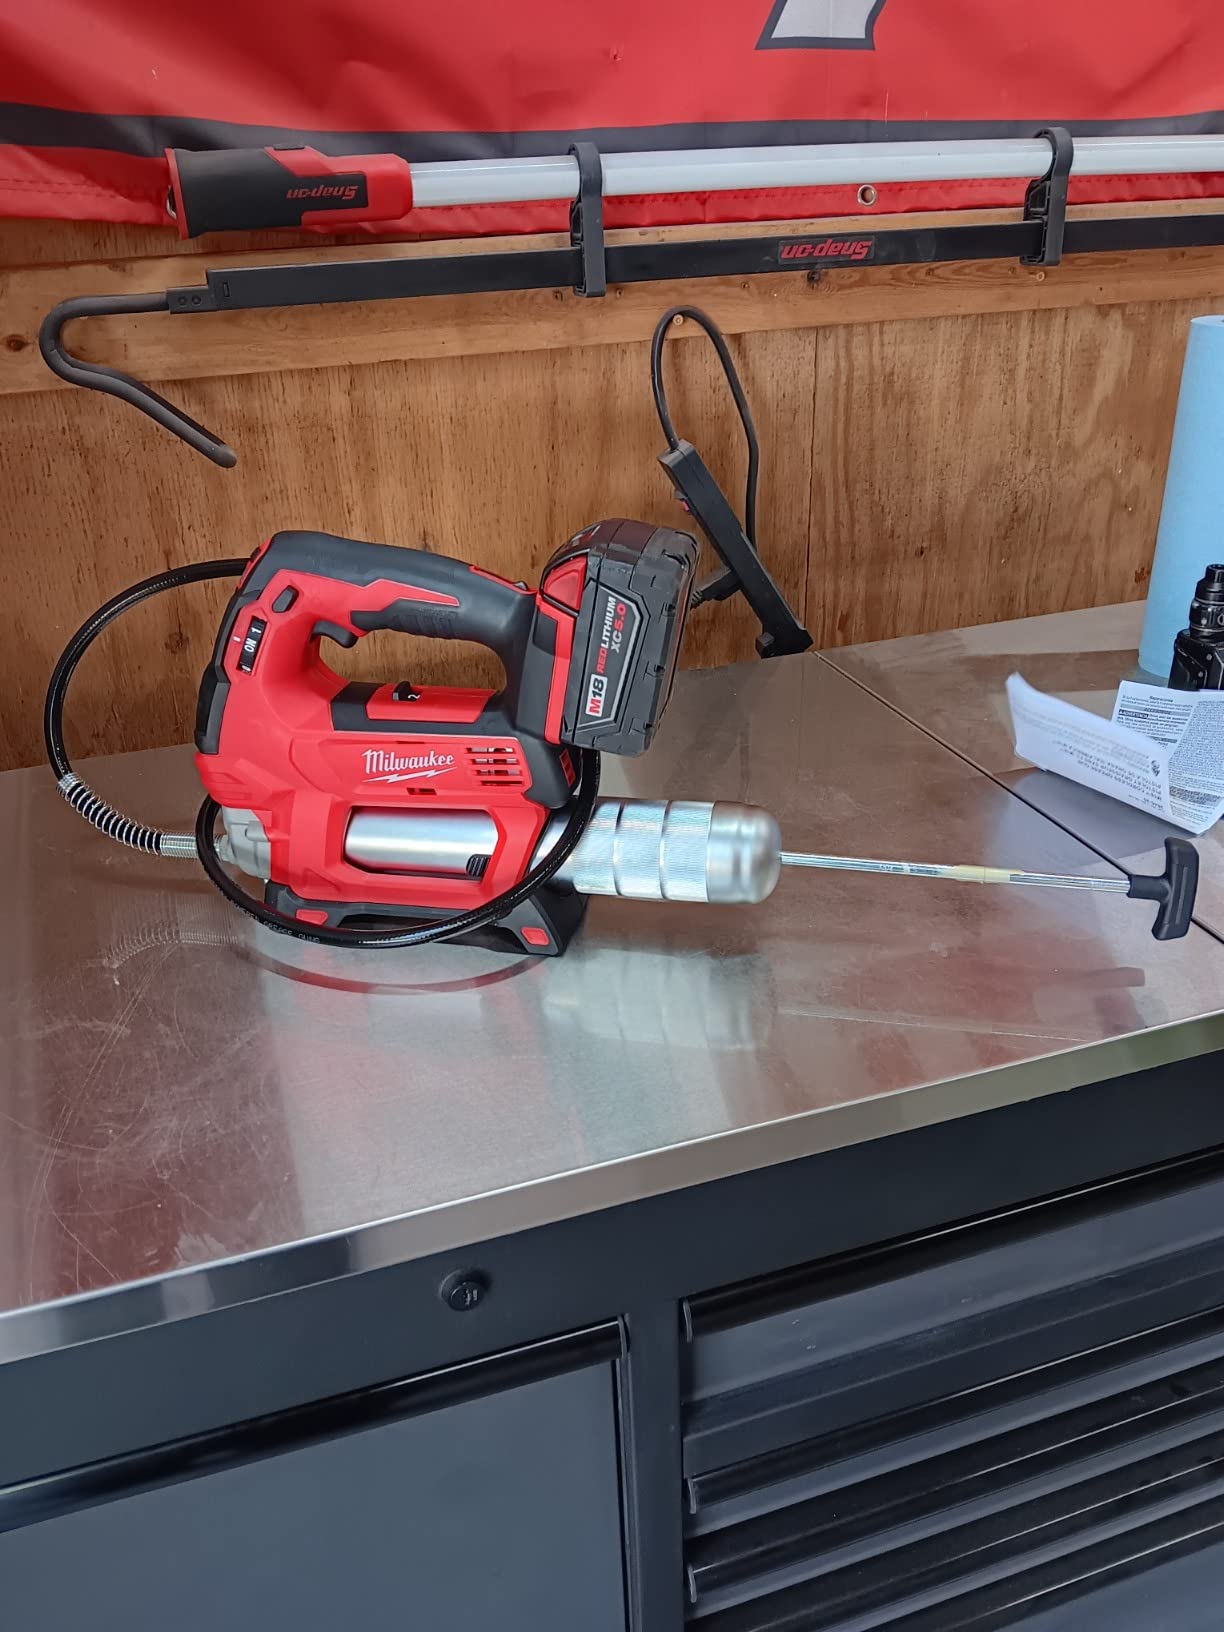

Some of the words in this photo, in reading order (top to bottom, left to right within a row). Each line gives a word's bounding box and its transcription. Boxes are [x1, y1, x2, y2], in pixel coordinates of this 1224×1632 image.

[286, 184, 358, 200] Snap-on
[781, 239, 873, 260] Snap-on
[596, 596, 617, 674] REDLITHIUM
[611, 603, 627, 654] XC5.0
[244, 637, 257, 653] ON
[588, 677, 605, 716] M18
[361, 749, 456, 774] Milwaukee
